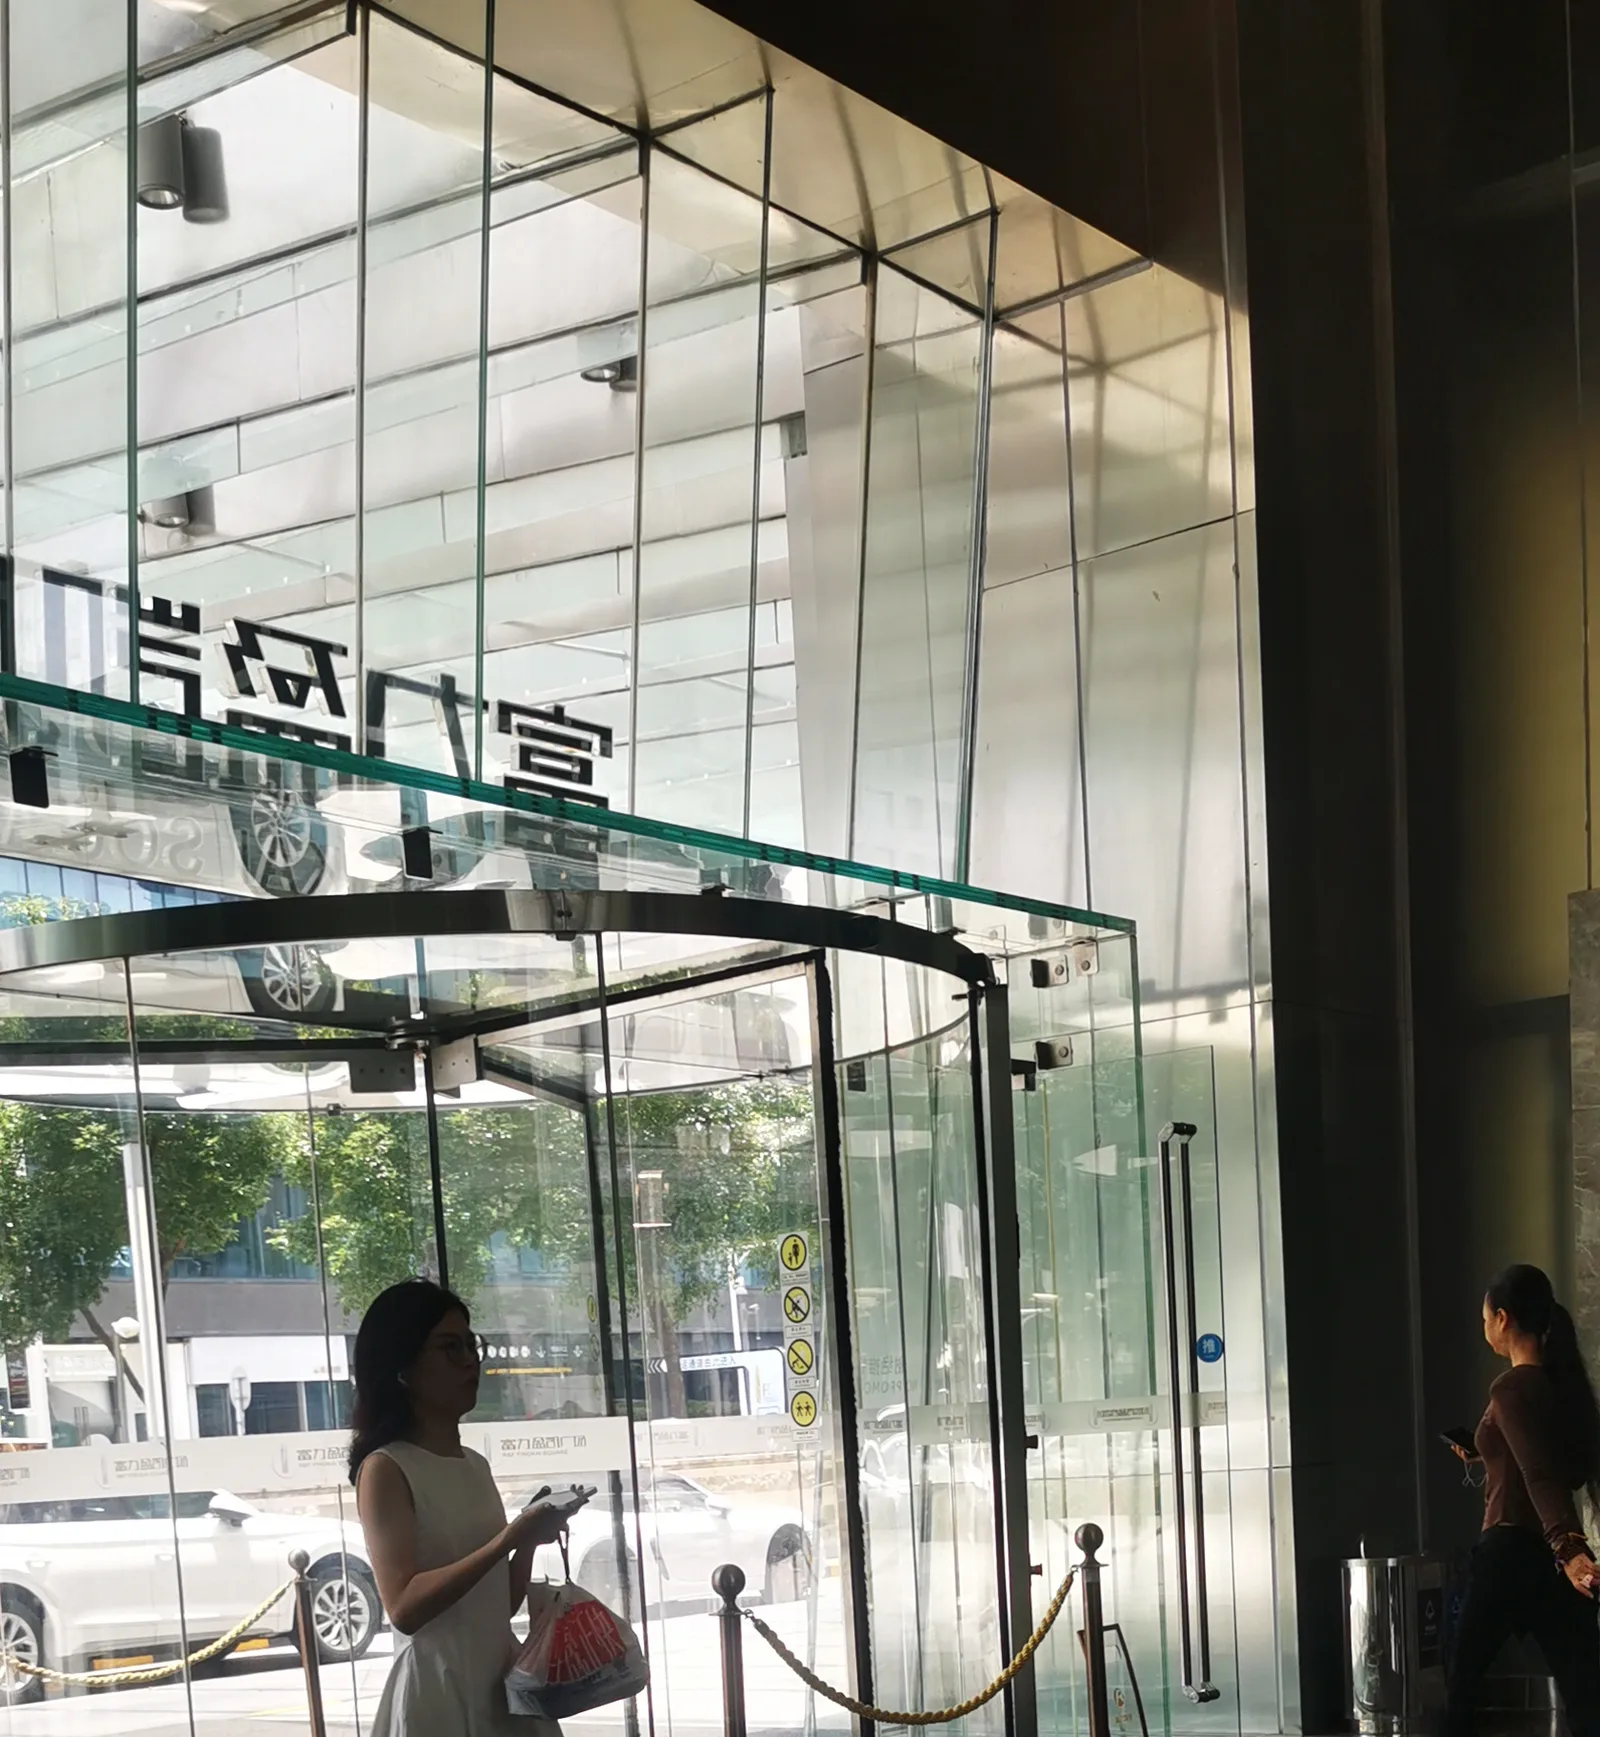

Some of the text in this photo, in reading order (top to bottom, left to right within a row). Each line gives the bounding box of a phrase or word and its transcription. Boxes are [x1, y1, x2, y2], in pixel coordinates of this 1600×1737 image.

[500, 1434, 587, 1451] 富力盈凯广场
